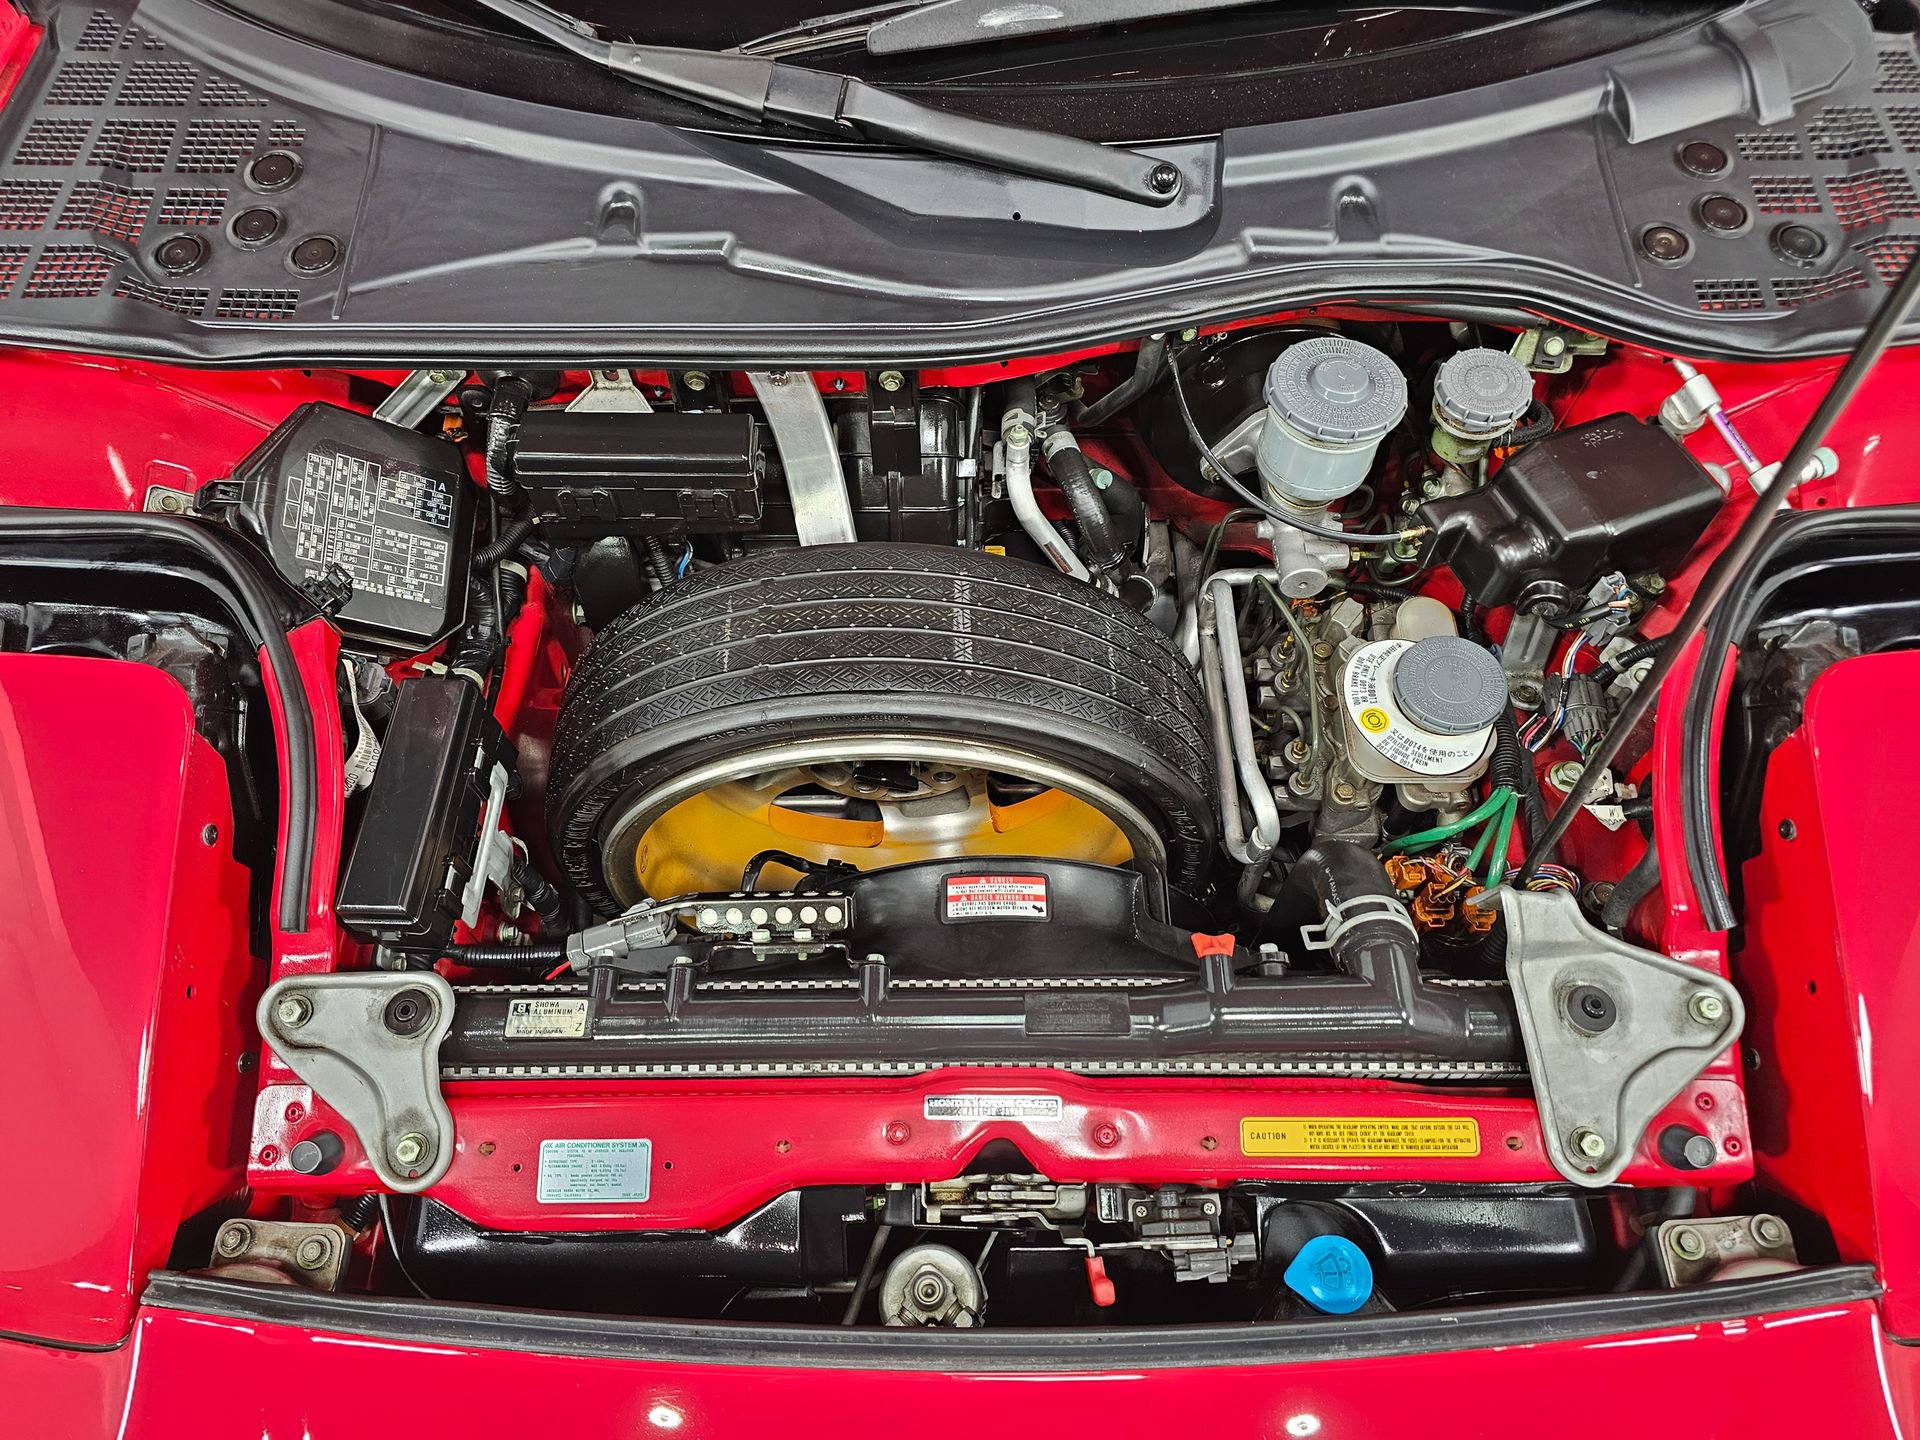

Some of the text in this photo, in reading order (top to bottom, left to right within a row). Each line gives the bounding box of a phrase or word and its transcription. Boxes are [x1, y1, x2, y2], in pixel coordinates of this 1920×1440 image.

[1302, 346, 1349, 359] WARNING
[438, 482, 446, 492] A
[420, 540, 431, 548] DOOR
[1354, 656, 1365, 670] DOT4
[1366, 653, 1376, 664] USE
[1361, 664, 1370, 677] ONLY
[1351, 671, 1360, 688] BRAKE
[1359, 680, 1367, 693] DOT3
[699, 720, 785, 744] TEMPORARY
[1376, 743, 1389, 755] DOT3
[1387, 734, 1443, 764] UTILISER SEULEMENT
[1390, 728, 1474, 758] 又はDOT4を使用のこと。
[1390, 745, 1410, 760] LIQUIDE
[1412, 757, 1429, 767] FREIN
[577, 1003, 585, 1012] A
[575, 1022, 582, 1031] Z
[1250, 1132, 1287, 1140] CAUTION
